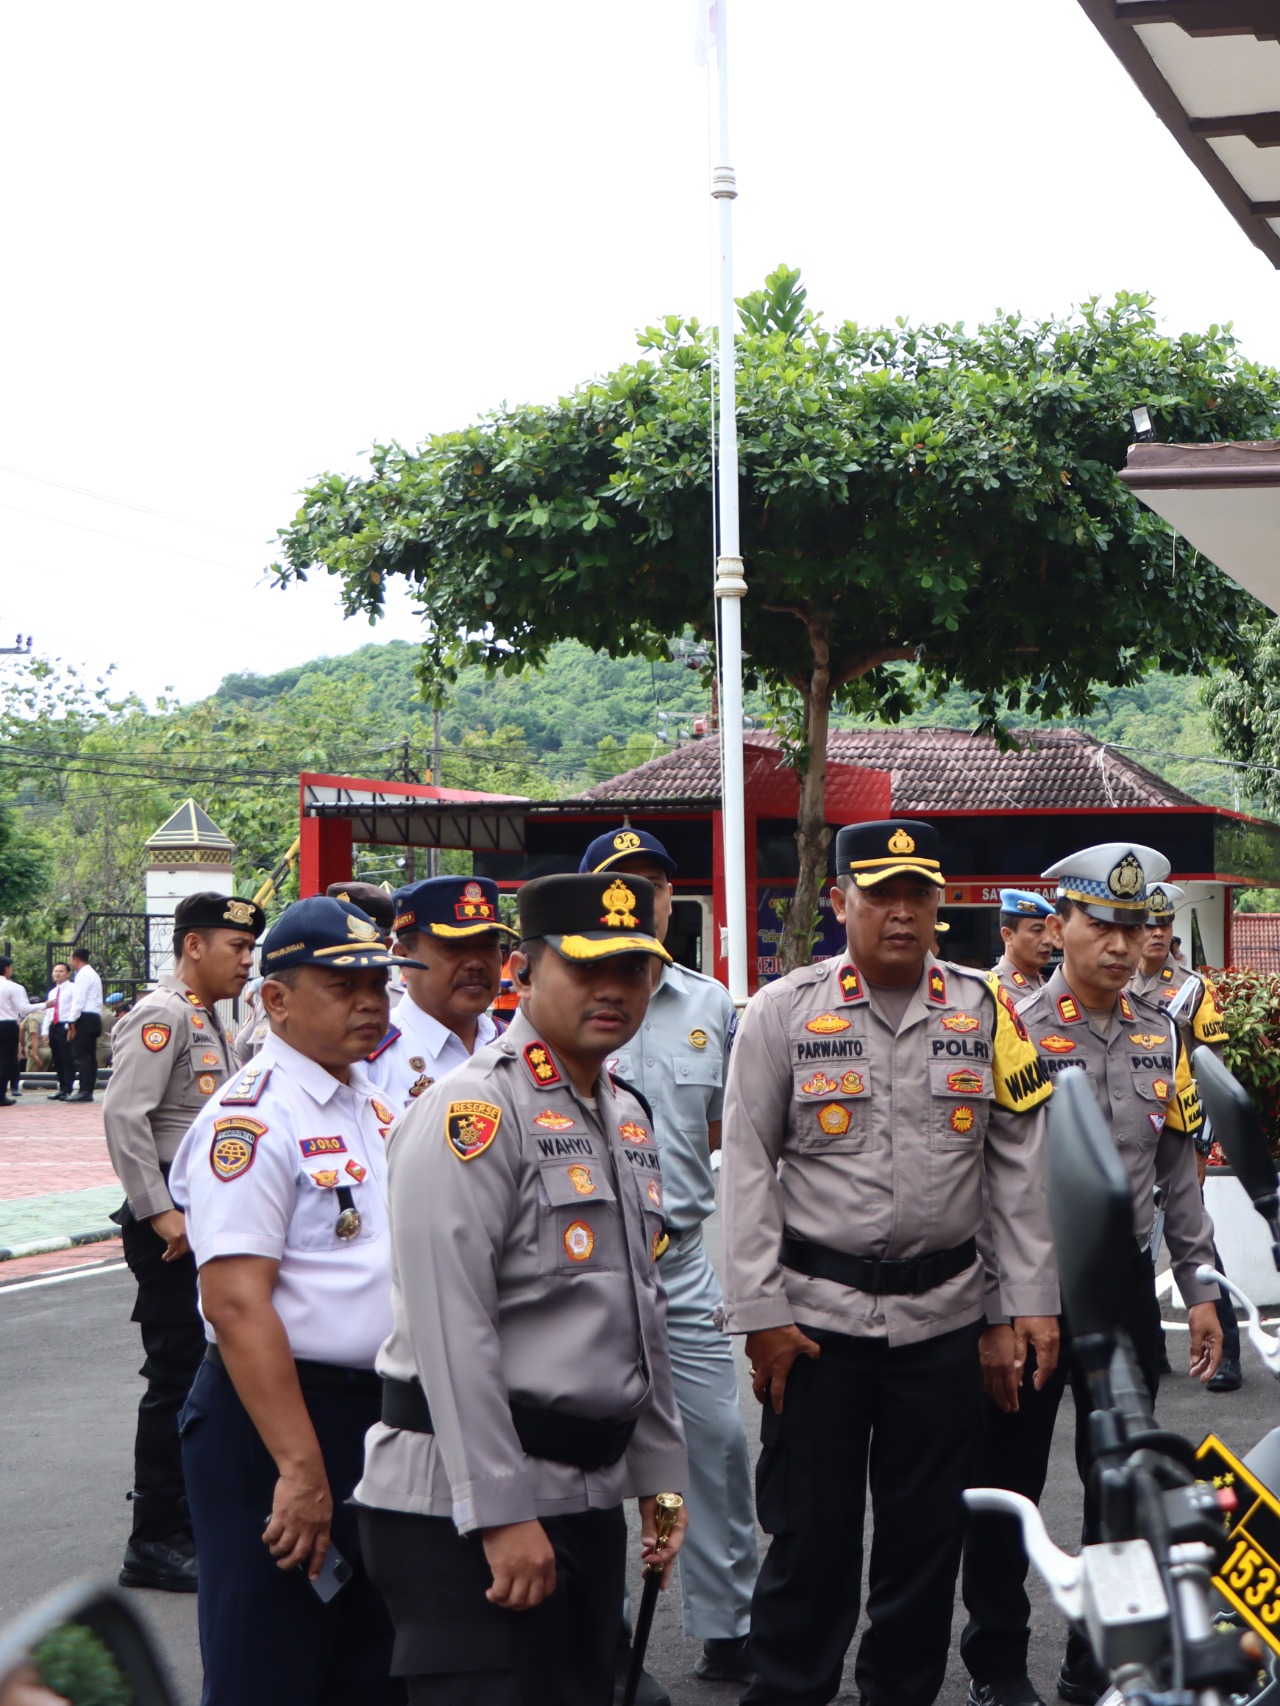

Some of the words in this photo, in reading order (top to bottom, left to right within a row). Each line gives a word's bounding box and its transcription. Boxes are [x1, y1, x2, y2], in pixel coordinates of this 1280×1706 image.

[797, 1039, 863, 1061] PARWANTO
[932, 1039, 989, 1059] POLRI
[1131, 1055, 1173, 1071] POLRI
[453, 1103, 499, 1118] RESERSE
[309, 1138, 340, 1152] JOKO
[538, 1138, 593, 1157] WAHYU
[625, 1149, 661, 1172] POLRI
